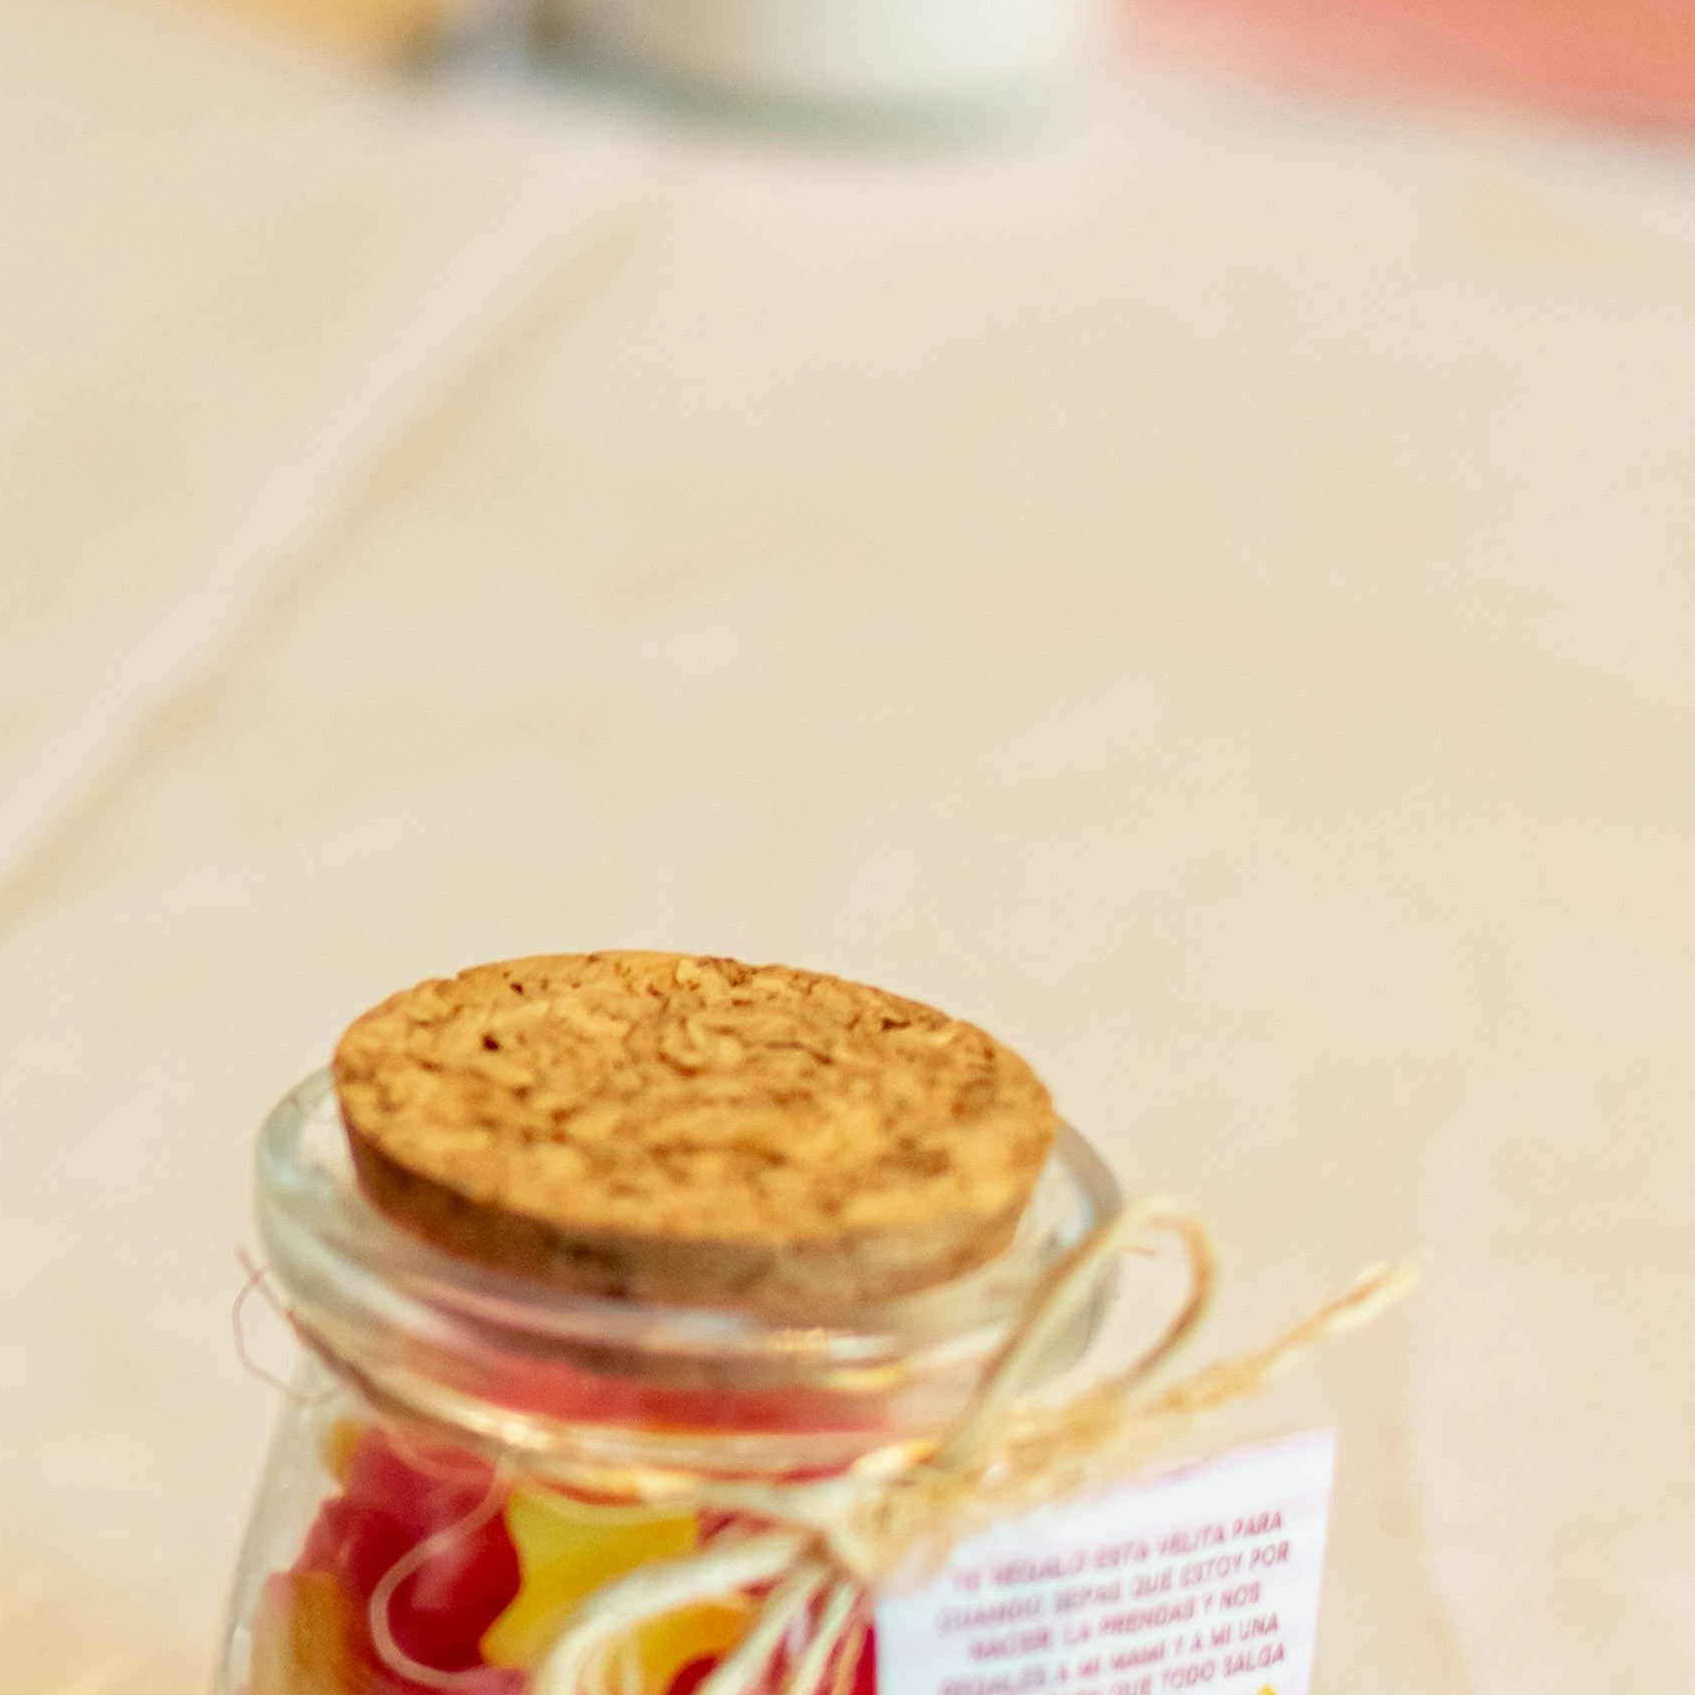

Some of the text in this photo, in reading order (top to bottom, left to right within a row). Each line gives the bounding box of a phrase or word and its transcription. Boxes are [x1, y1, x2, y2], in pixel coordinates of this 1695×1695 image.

[1232, 1509, 1284, 1539] PARA
[1179, 1551, 1243, 1588] ESTOY
[1249, 1539, 1291, 1570] POR
[1099, 1596, 1195, 1637] PRENDAS
[1202, 1591, 1214, 1614] Y
[1219, 1580, 1261, 1611] NOS
[1189, 1631, 1203, 1654] A
[1238, 1610, 1280, 1643] UNA
[1160, 1658, 1216, 1691] TODO
[1222, 1641, 1285, 1678] SALGA
